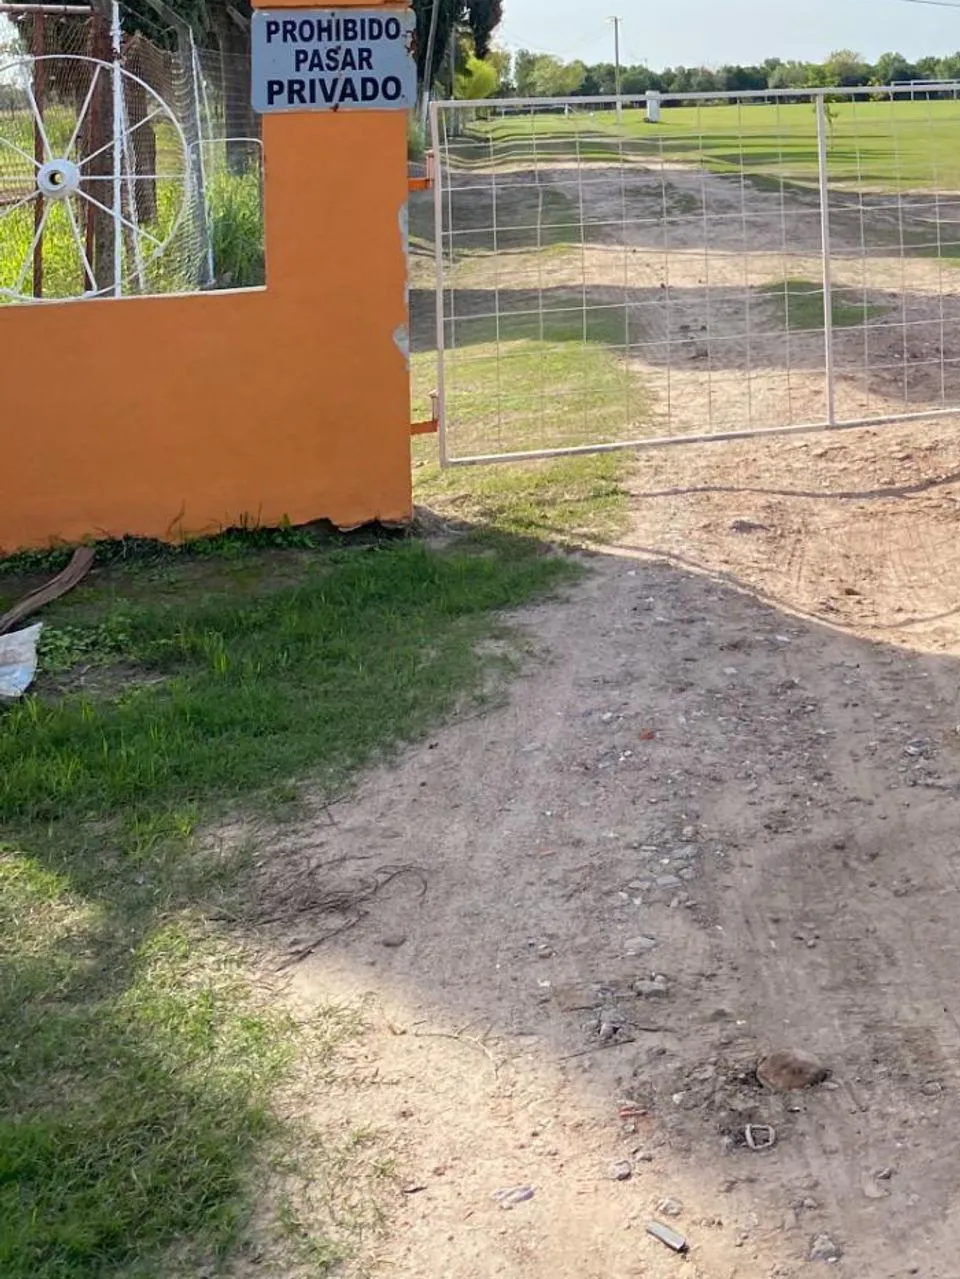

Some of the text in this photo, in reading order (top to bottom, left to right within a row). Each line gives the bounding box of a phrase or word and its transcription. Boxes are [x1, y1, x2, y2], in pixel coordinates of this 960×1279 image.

[266, 17, 401, 43] PROHIBIDO
[295, 47, 373, 72] PASAR
[267, 75, 402, 105] PRIVADO
